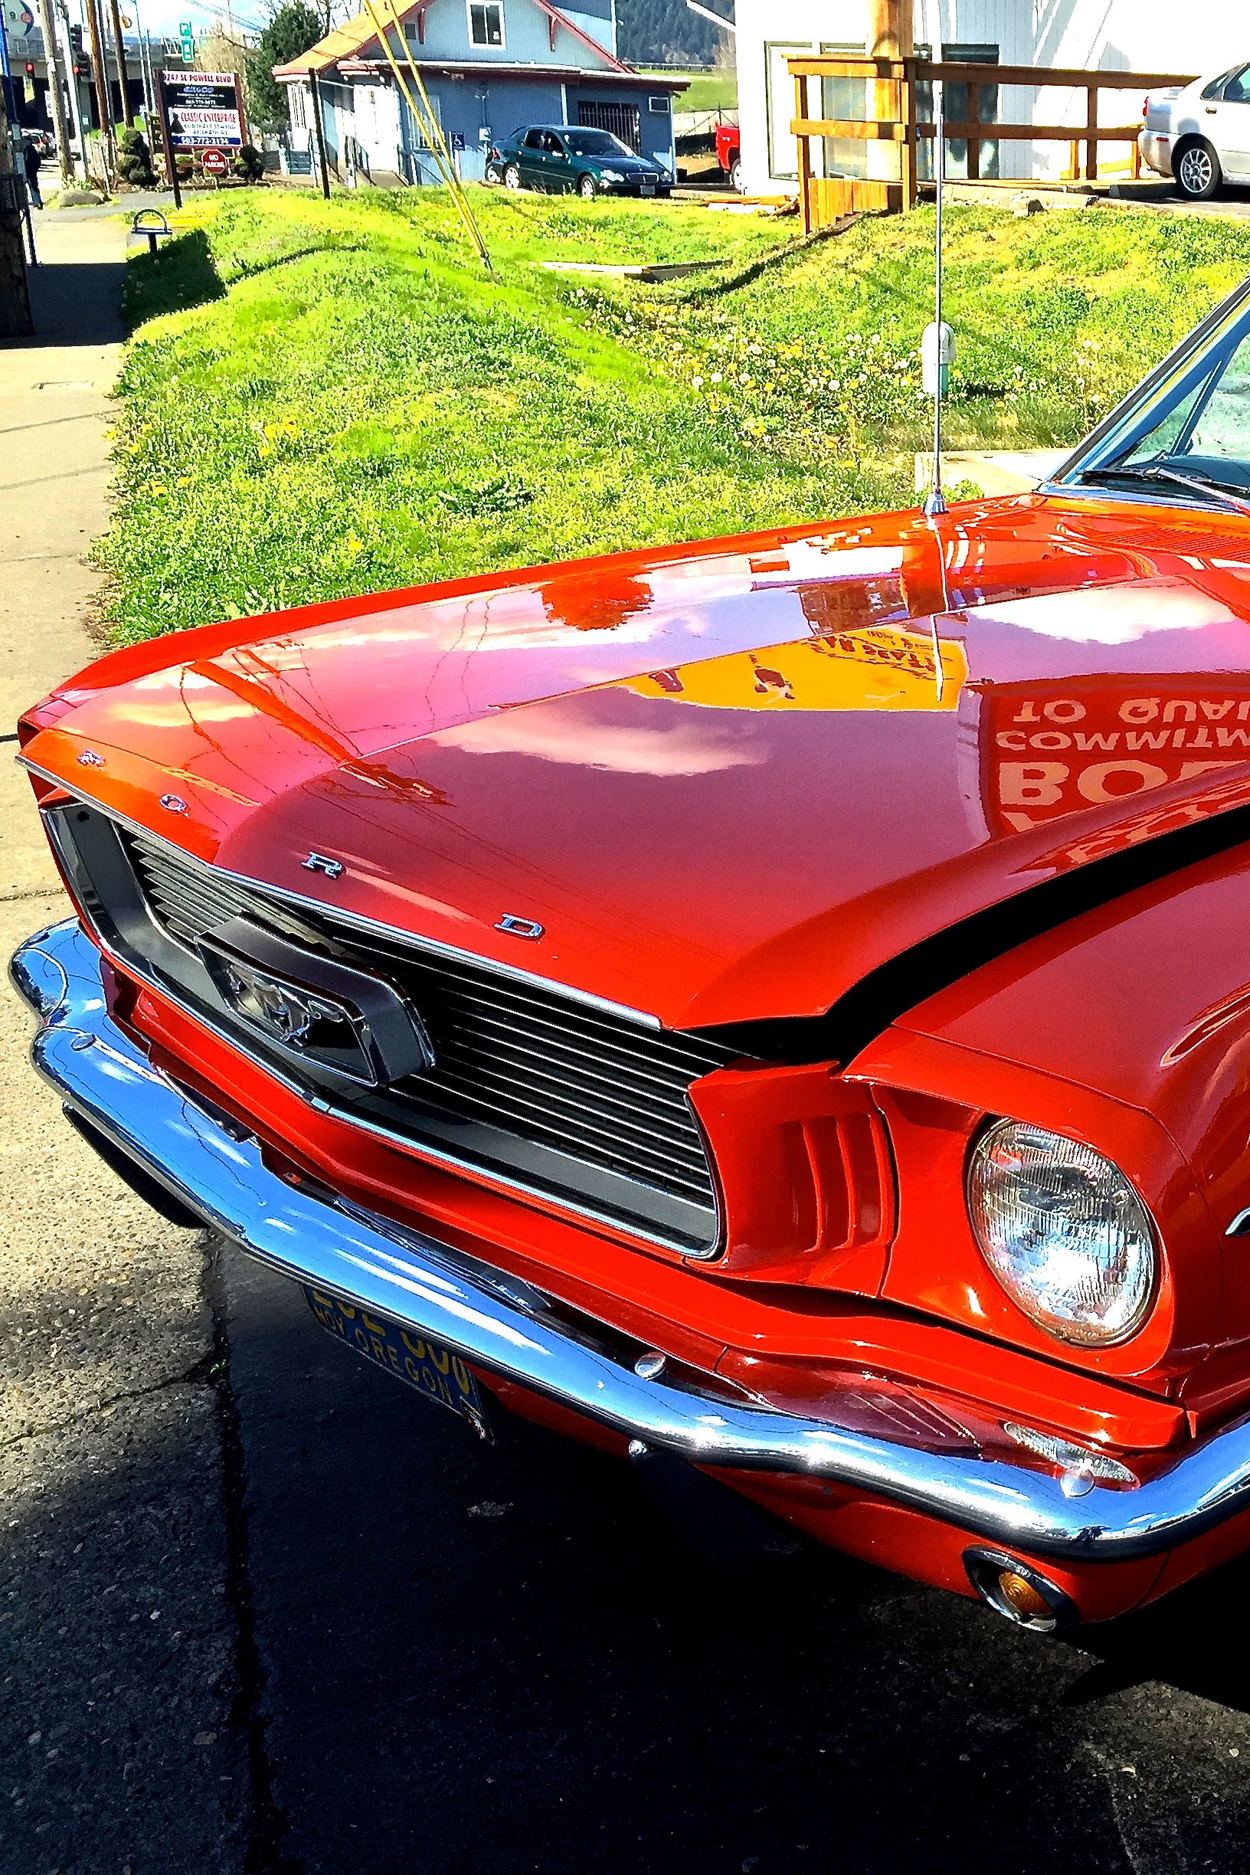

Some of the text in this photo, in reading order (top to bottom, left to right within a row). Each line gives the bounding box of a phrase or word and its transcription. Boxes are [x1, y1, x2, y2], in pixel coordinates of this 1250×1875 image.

[189, 74, 214, 83] POWELL
[215, 75, 232, 83] BLVD
[180, 111, 202, 123] CLASSIC
[354, 1328, 454, 1405] OREGON
